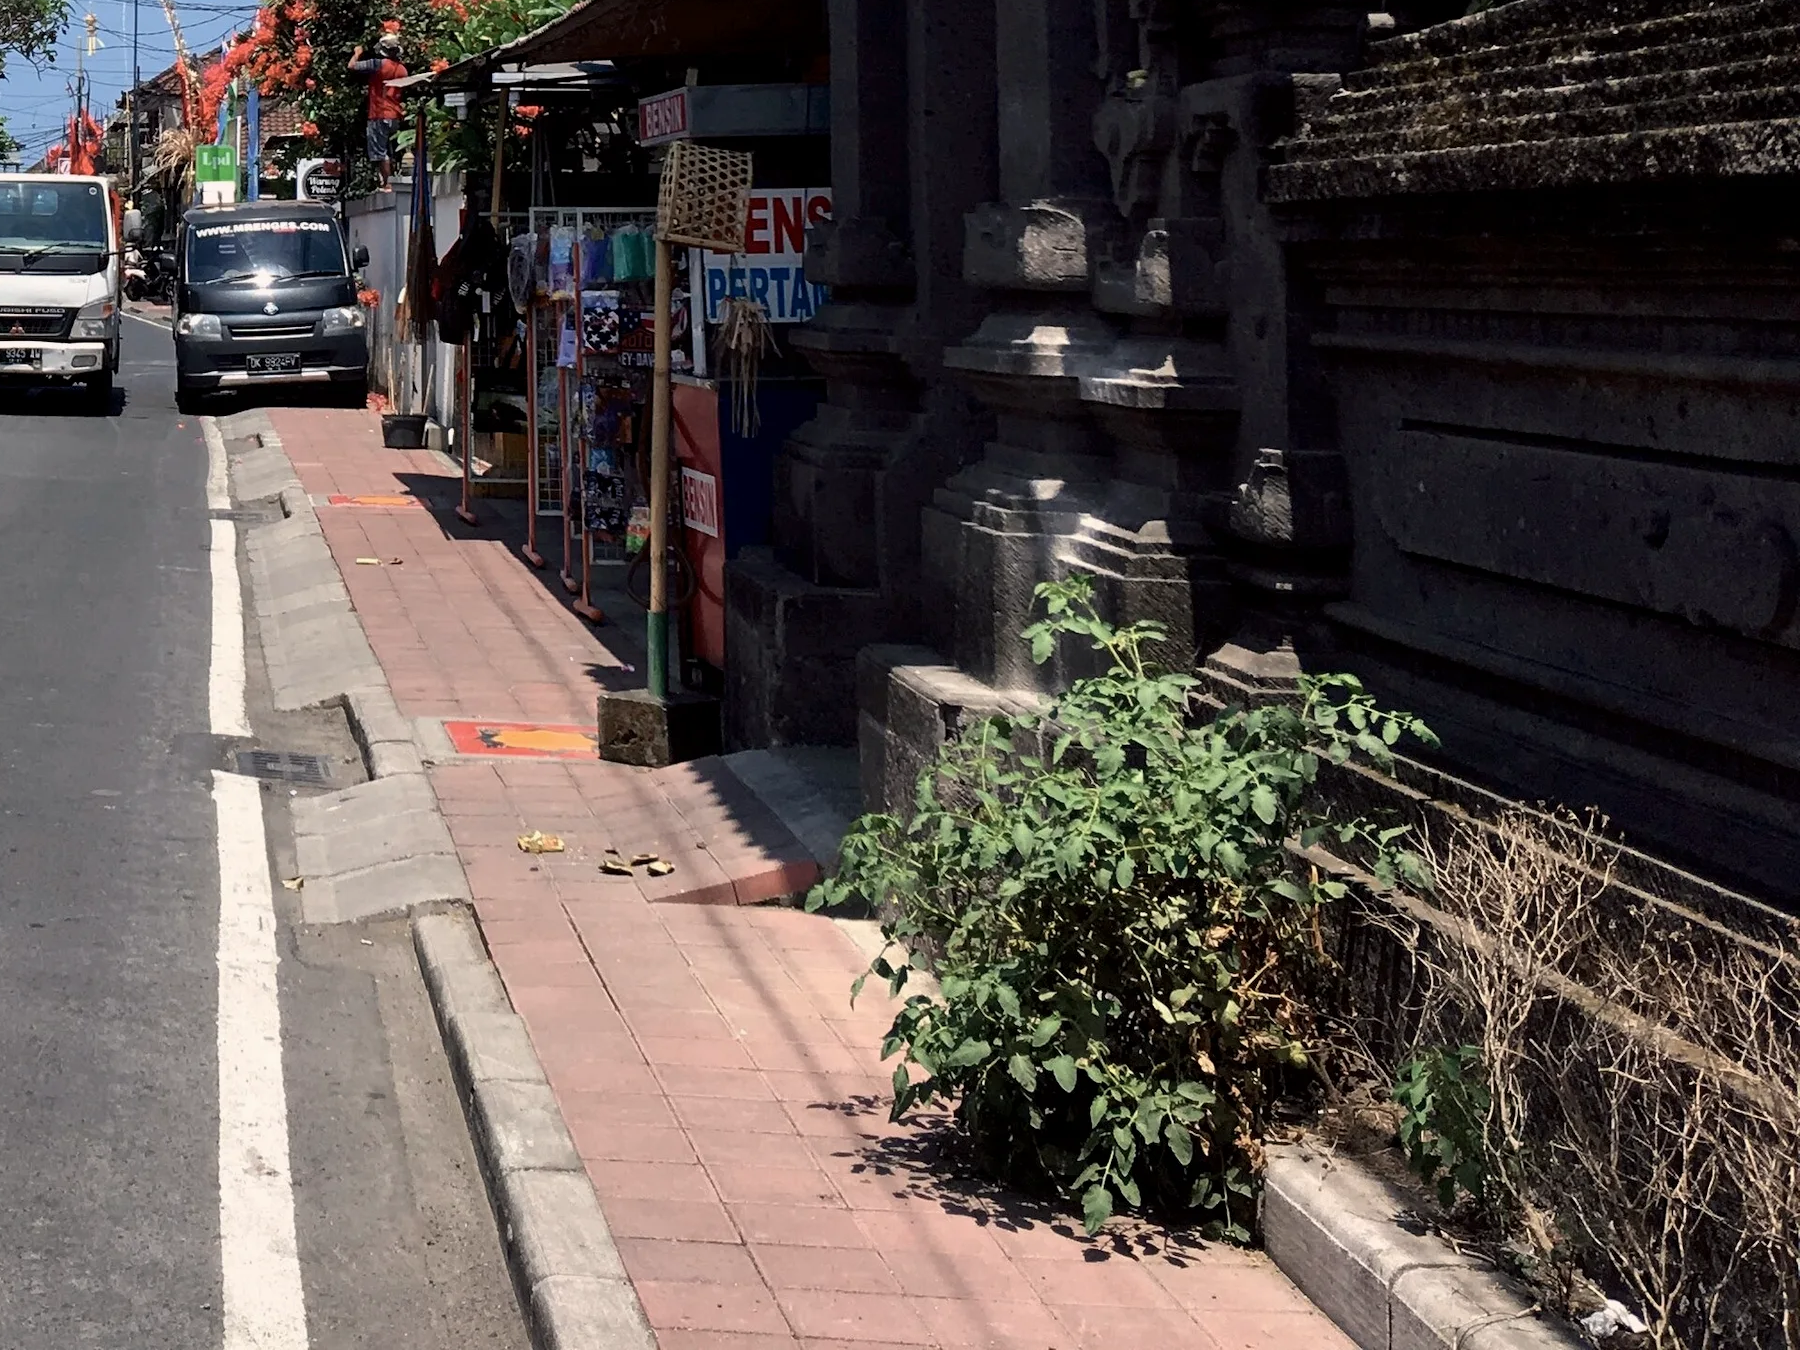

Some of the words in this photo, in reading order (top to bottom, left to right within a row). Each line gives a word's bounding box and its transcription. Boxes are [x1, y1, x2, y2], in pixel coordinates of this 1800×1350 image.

[646, 94, 683, 137] BENSIN
[202, 152, 231, 170] Lpd
[307, 176, 340, 188] Warung
[713, 195, 833, 255] ENS
[250, 357, 261, 368] DK
[683, 474, 716, 529] BENSIN
